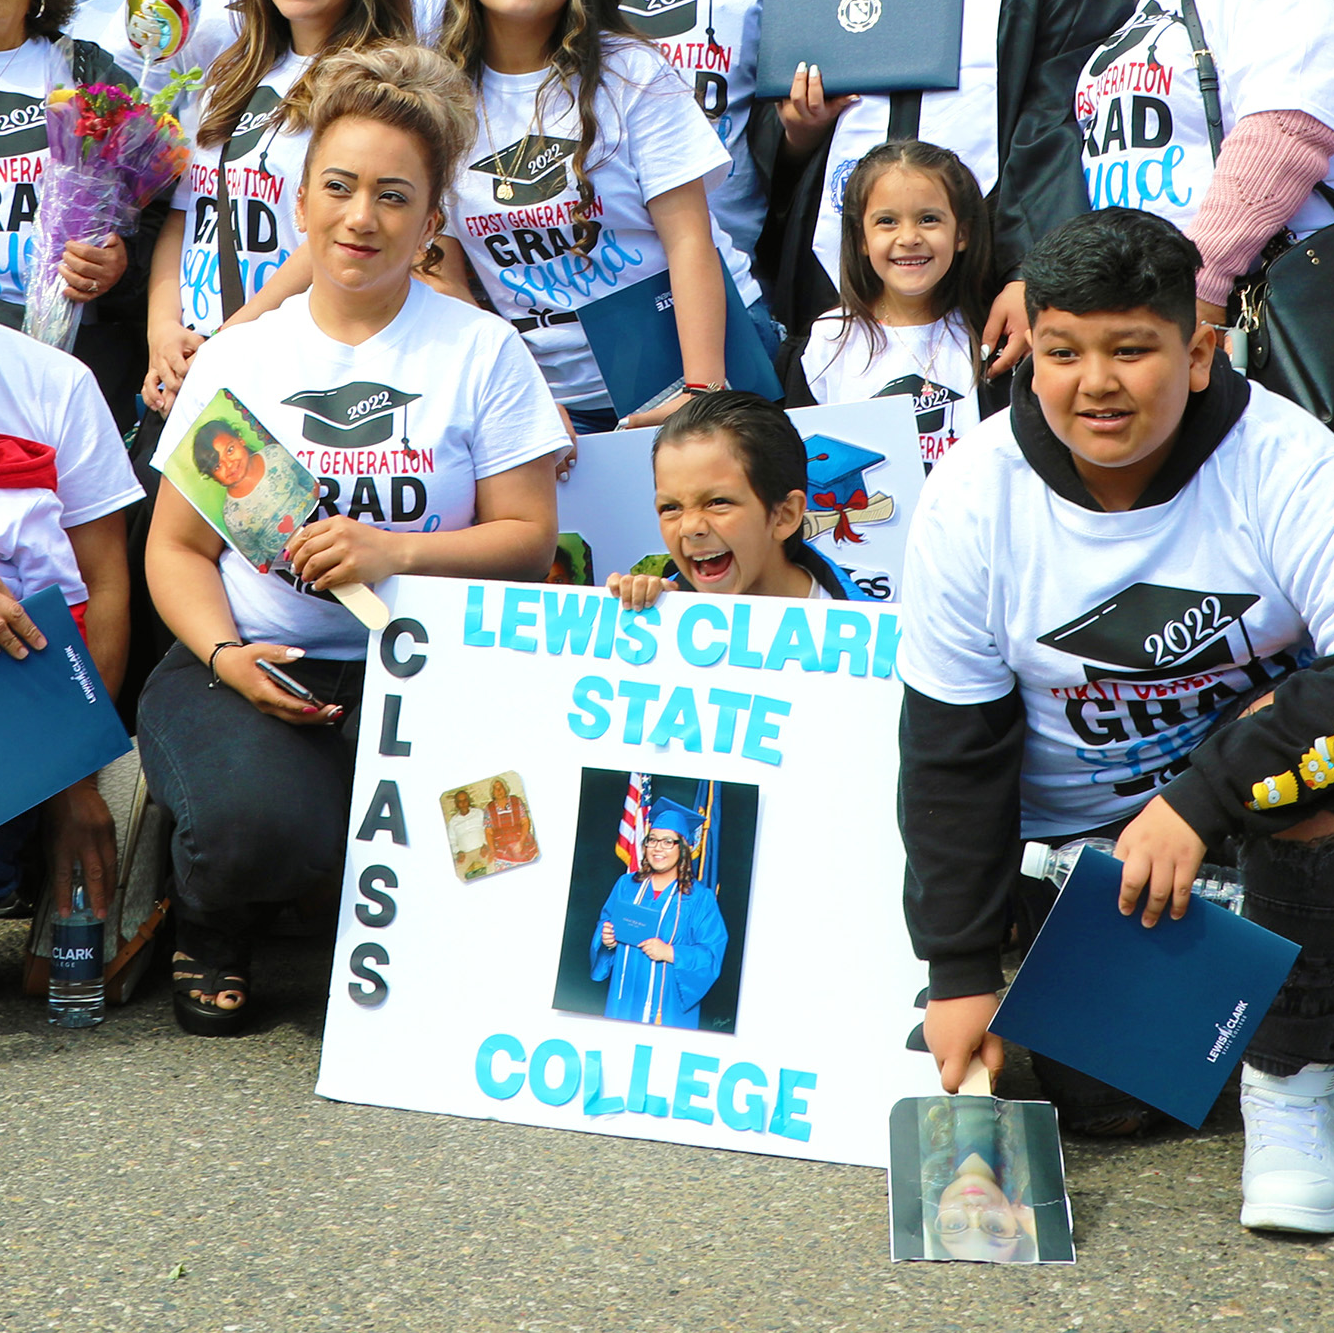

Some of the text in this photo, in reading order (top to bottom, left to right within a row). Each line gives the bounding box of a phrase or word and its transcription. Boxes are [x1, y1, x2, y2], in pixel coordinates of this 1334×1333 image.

[527, 143, 564, 176] 2022
[465, 212, 507, 239] FIRST
[484, 220, 603, 268] GRAD
[347, 391, 393, 421] 2022
[320, 448, 435, 475] GENERATION
[463, 585, 661, 665] LEWIS
[1144, 596, 1233, 666] 2022
[63, 644, 83, 673] CLARK
[567, 676, 793, 767] STATE
[348, 617, 430, 1008] CLASS
[52, 947, 94, 960] CLARK
[1206, 999, 1249, 1064] LEWIS CLARK
[475, 1034, 818, 1142] COLLEGE
